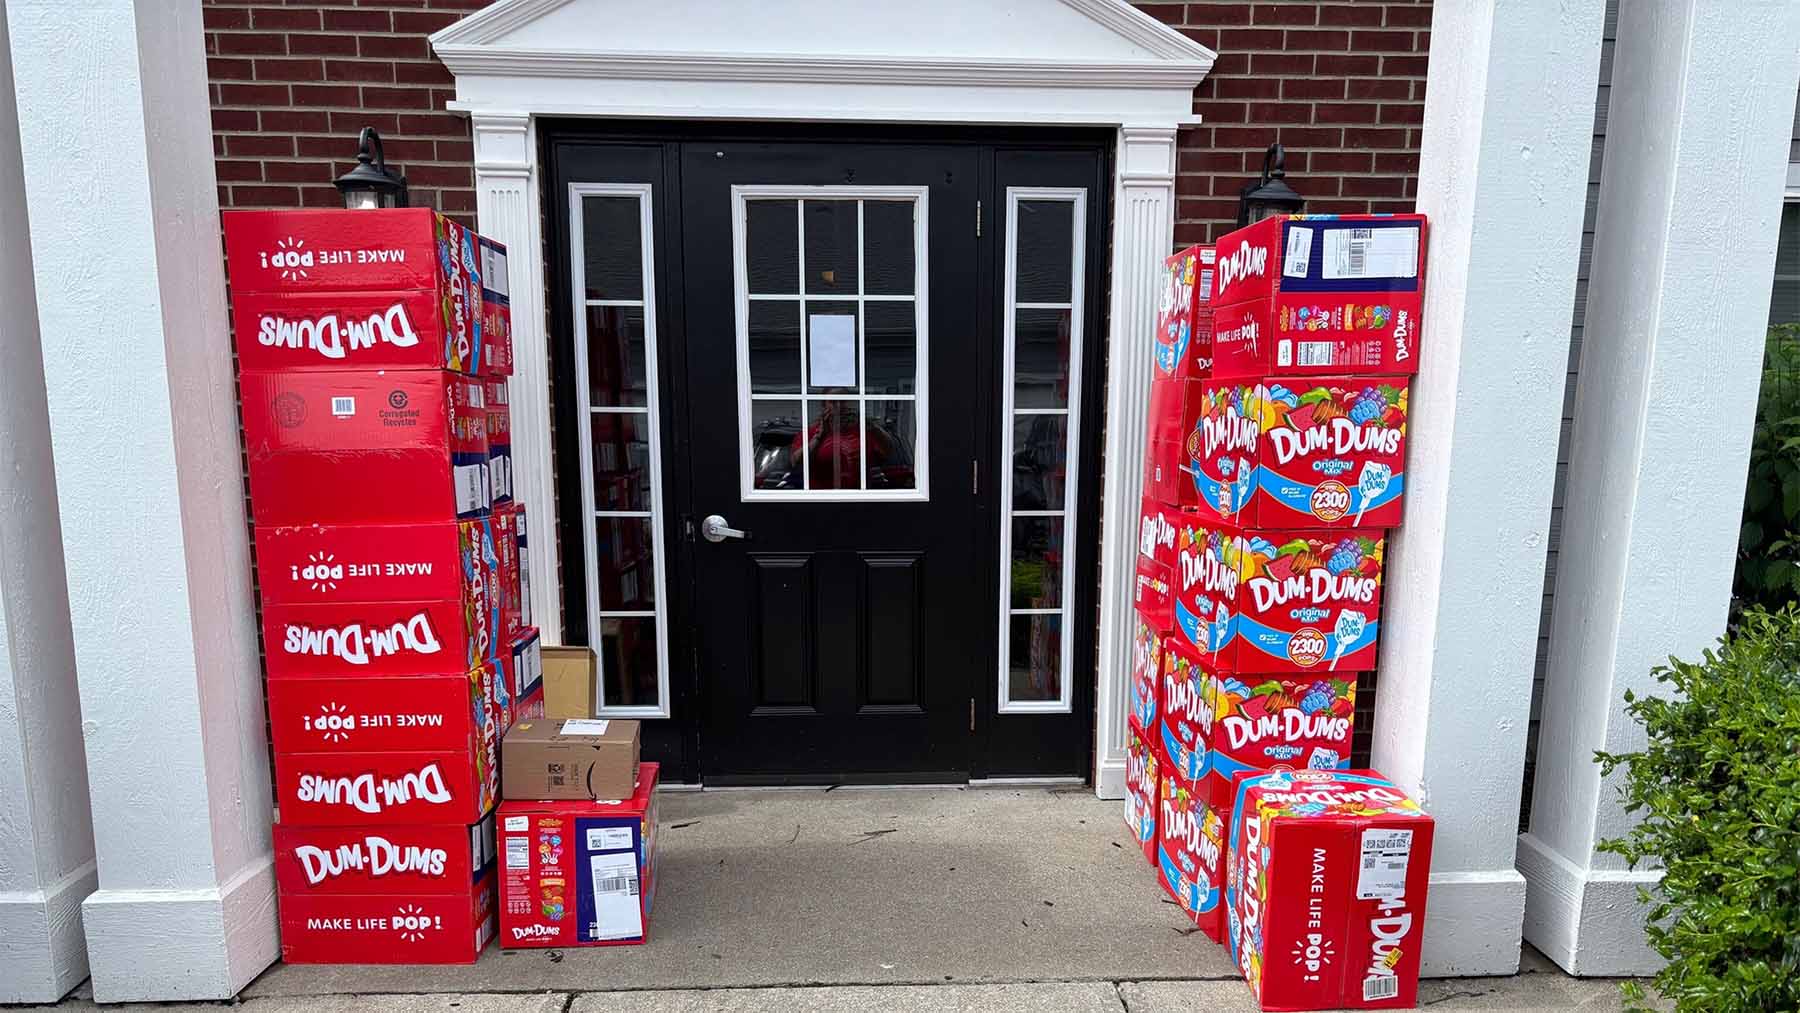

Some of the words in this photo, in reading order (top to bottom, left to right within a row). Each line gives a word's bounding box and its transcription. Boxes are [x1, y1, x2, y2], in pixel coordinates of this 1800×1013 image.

[261, 251, 314, 269] POP!
[320, 250, 352, 264] LIFE
[358, 250, 405, 264] MAKE
[379, 409, 420, 419] Corrugated
[384, 418, 416, 427] Recycles
[1312, 458, 1353, 472] Original
[1313, 492, 1348, 508] 2300
[291, 564, 343, 581] POP!
[348, 564, 380, 576] LIFE
[385, 563, 433, 575] MAKE
[1290, 607, 1331, 620] Original
[1290, 638, 1325, 654] 2300
[304, 715, 355, 731] POP!
[360, 715, 391, 727] LIFE
[396, 714, 443, 726] MAKE
[1264, 745, 1304, 757] Original
[1311, 848, 1326, 893] MAKE
[1309, 898, 1323, 928] LIFE
[307, 918, 352, 930] MAKE
[357, 918, 388, 930] LIFE
[392, 915, 442, 930] POP!
[1303, 934, 1323, 983] POP!
